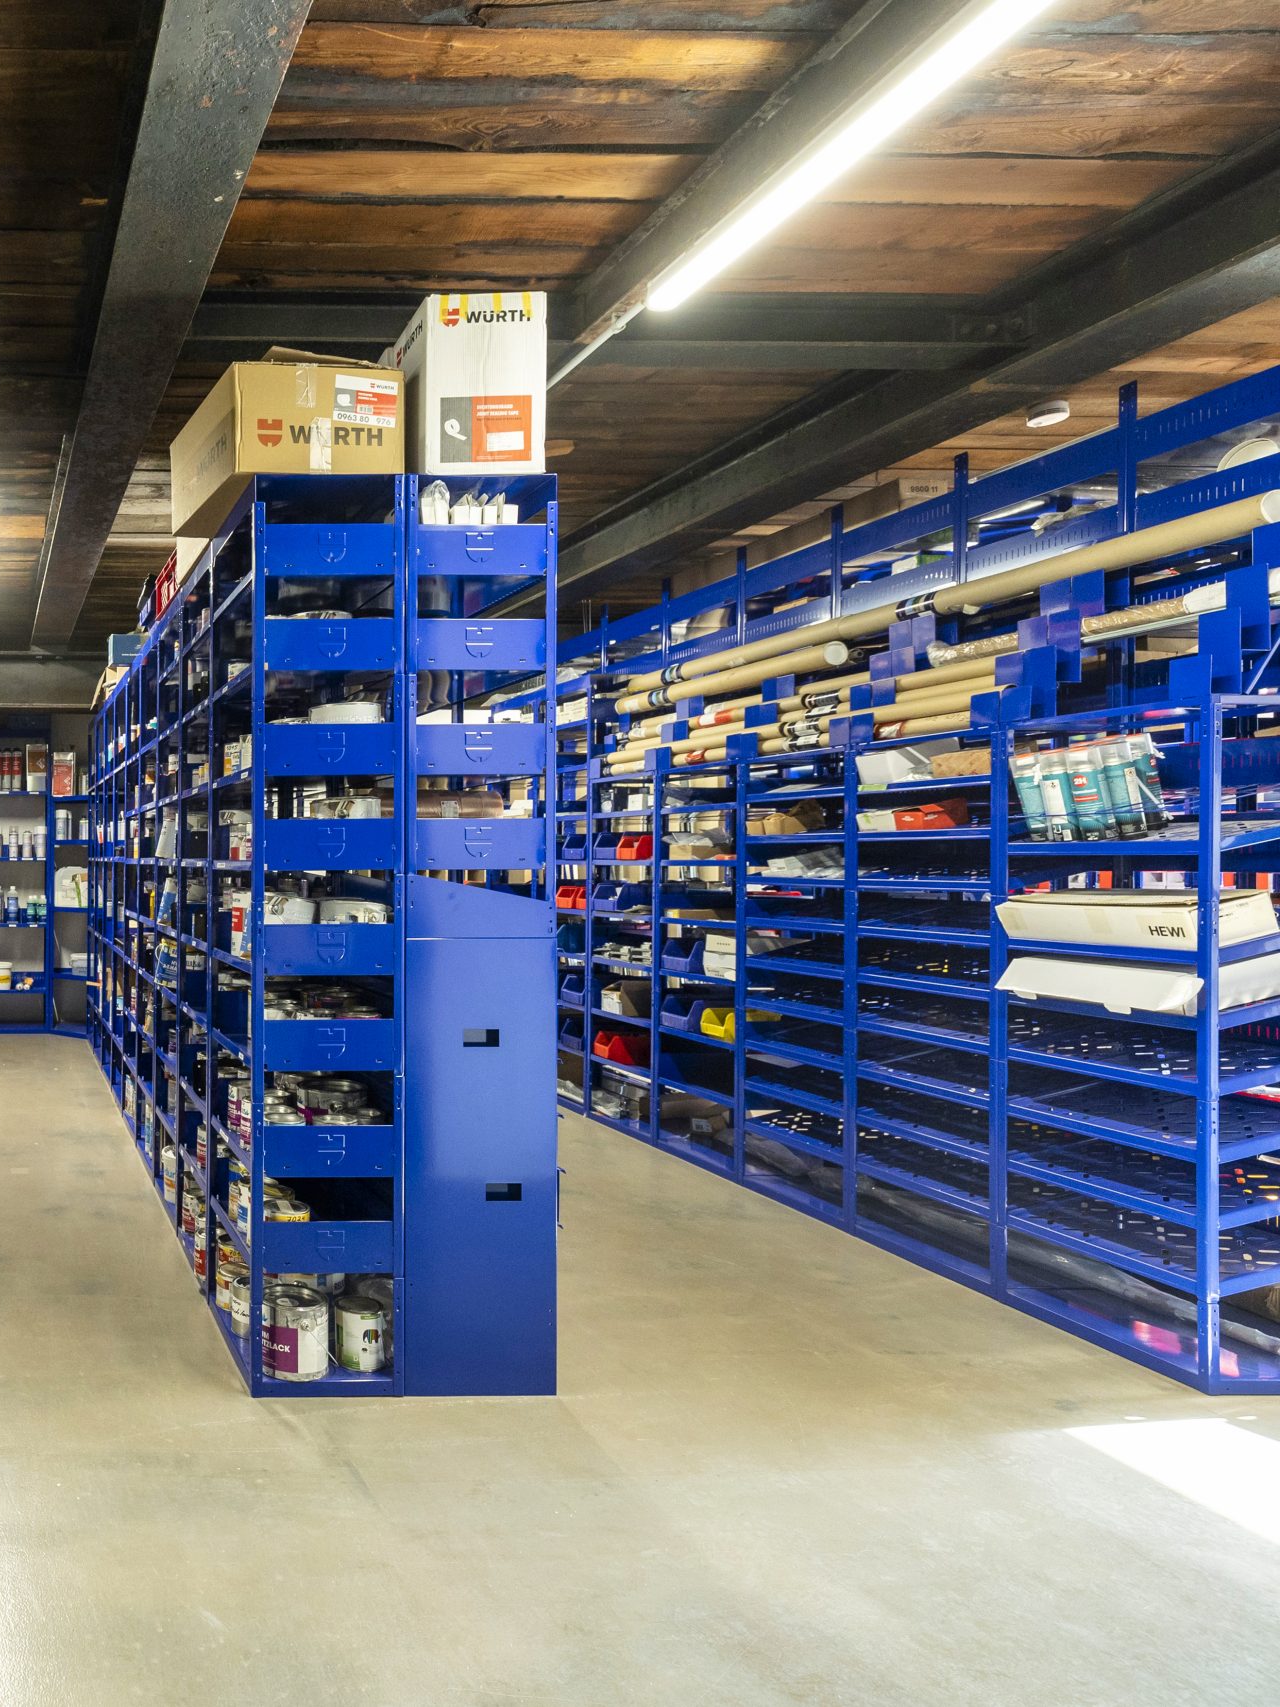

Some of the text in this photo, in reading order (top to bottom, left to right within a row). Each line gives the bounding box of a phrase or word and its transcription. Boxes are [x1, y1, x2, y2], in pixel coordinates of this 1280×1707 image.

[465, 309, 531, 323] WÜRTH
[403, 320, 423, 357] WÜRTH
[337, 413, 391, 425] 0963 80 976
[290, 424, 383, 447] WRTH
[1148, 925, 1187, 938] HEWI
